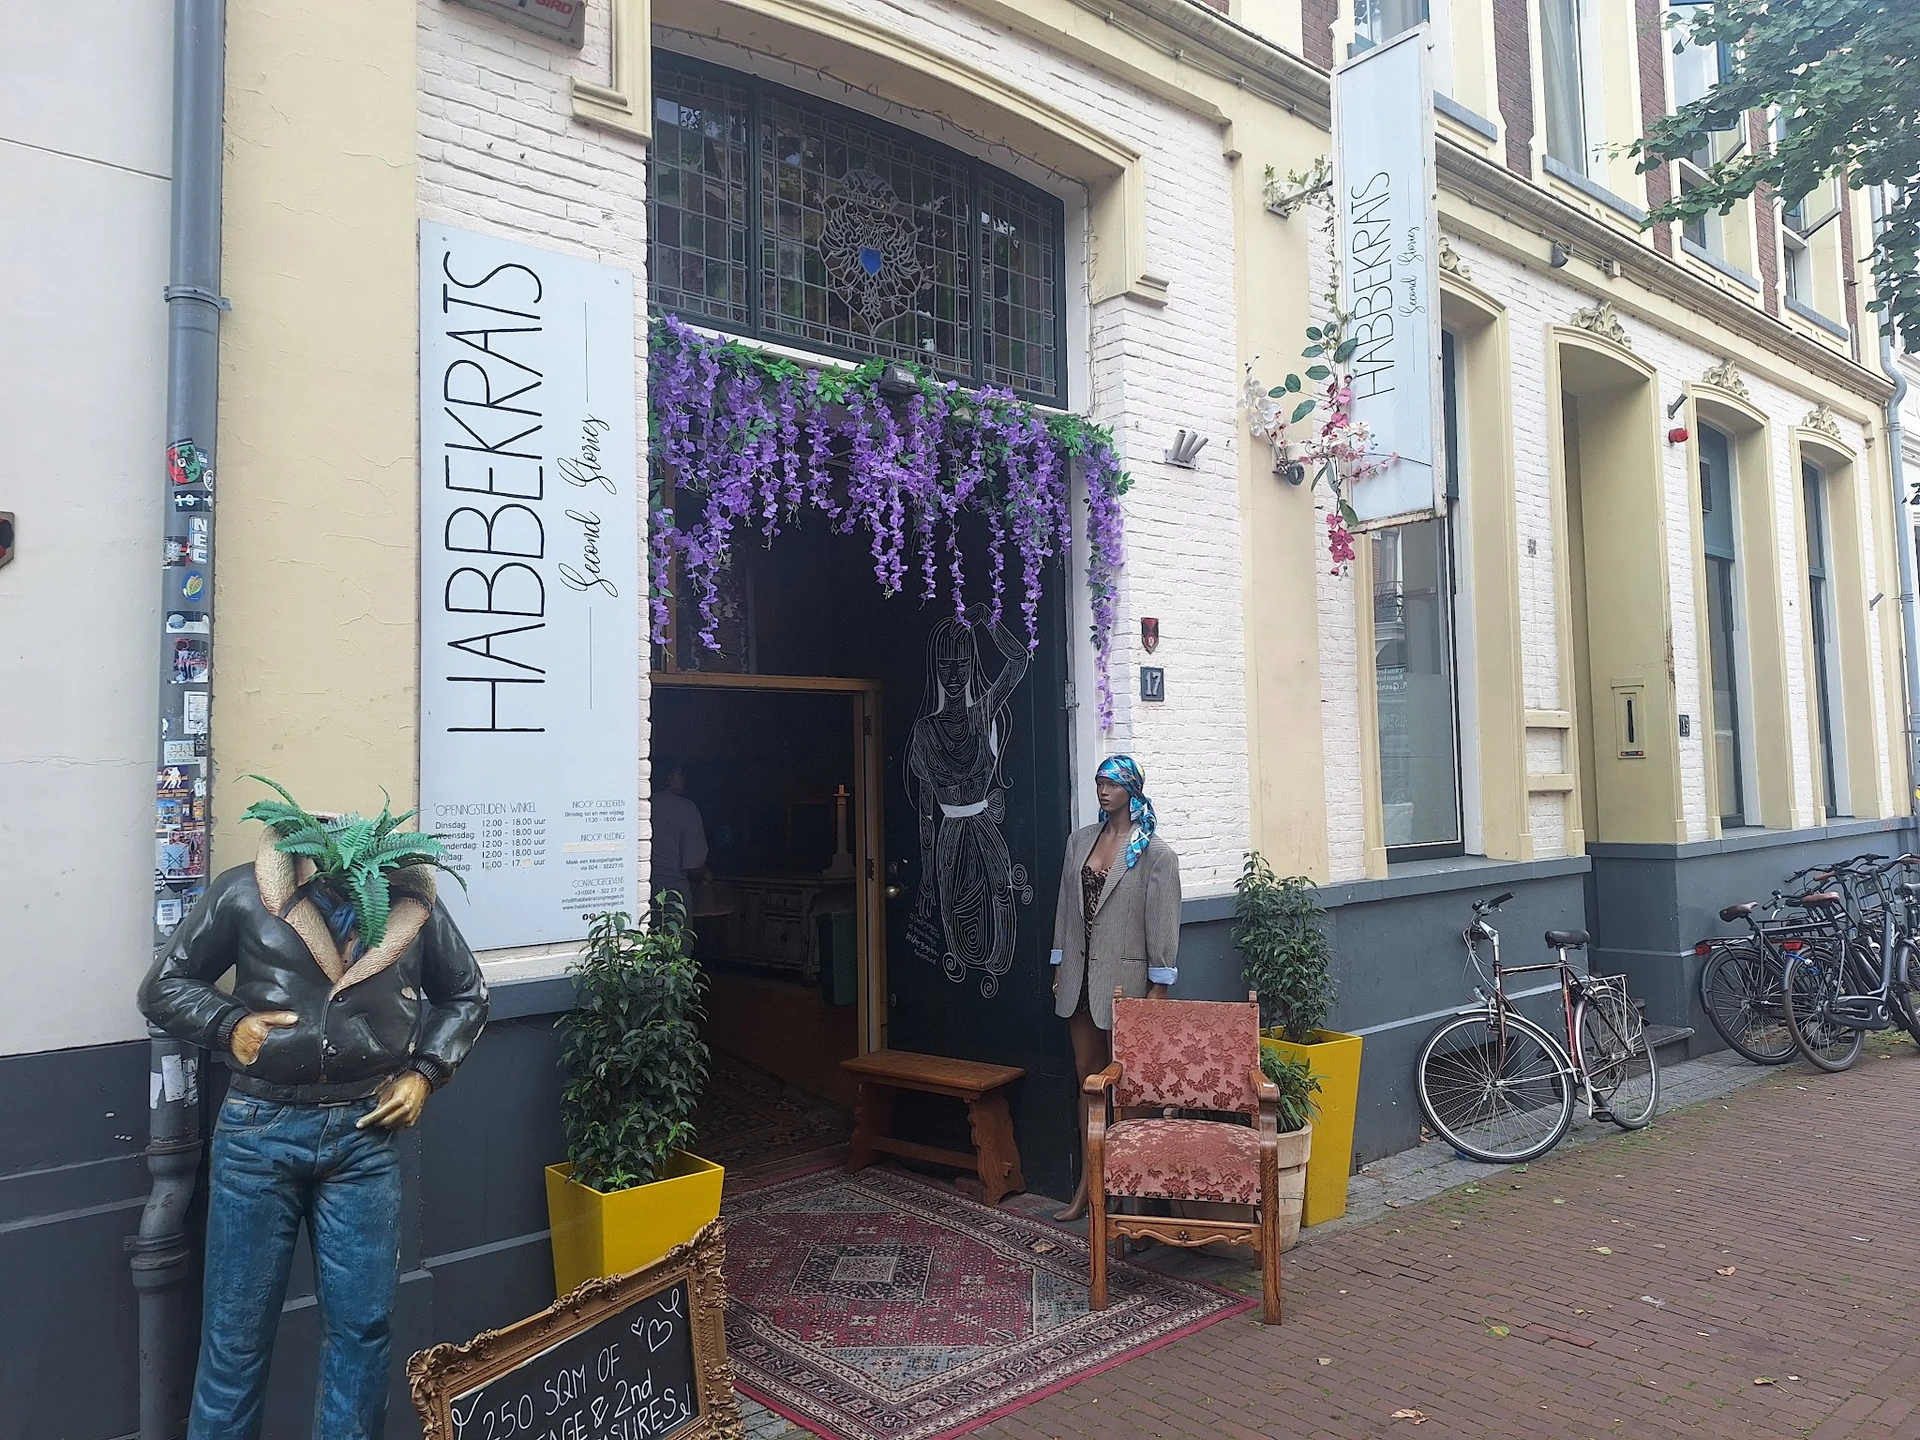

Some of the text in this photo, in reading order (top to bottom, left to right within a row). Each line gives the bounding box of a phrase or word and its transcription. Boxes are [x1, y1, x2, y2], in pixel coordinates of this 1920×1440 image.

[1350, 171, 1395, 400] HABBEKRATS
[1397, 226, 1426, 317] Second Stories
[443, 251, 545, 733] HABBEKRATS
[557, 412, 618, 598] Second Stories
[190, 517, 208, 564] NEC
[1145, 671, 1161, 696] 17
[435, 821, 467, 830] Dinsdag:
[482, 819, 502, 827] 12.00
[512, 818, 532, 826] 18.00
[510, 802, 537, 813] WINKEL
[440, 841, 478, 850] onderdag:
[482, 840, 502, 848] 12.00
[512, 839, 532, 847] 18.00
[482, 829, 502, 837] 12.00
[512, 828, 532, 836] 18.00
[482, 850, 502, 858] 12.00
[512, 849, 532, 857] 18.00
[483, 1343, 620, 1440] 250 SQM OF
[591, 1396, 609, 1429] &
[614, 1369, 653, 1418] 2nd
